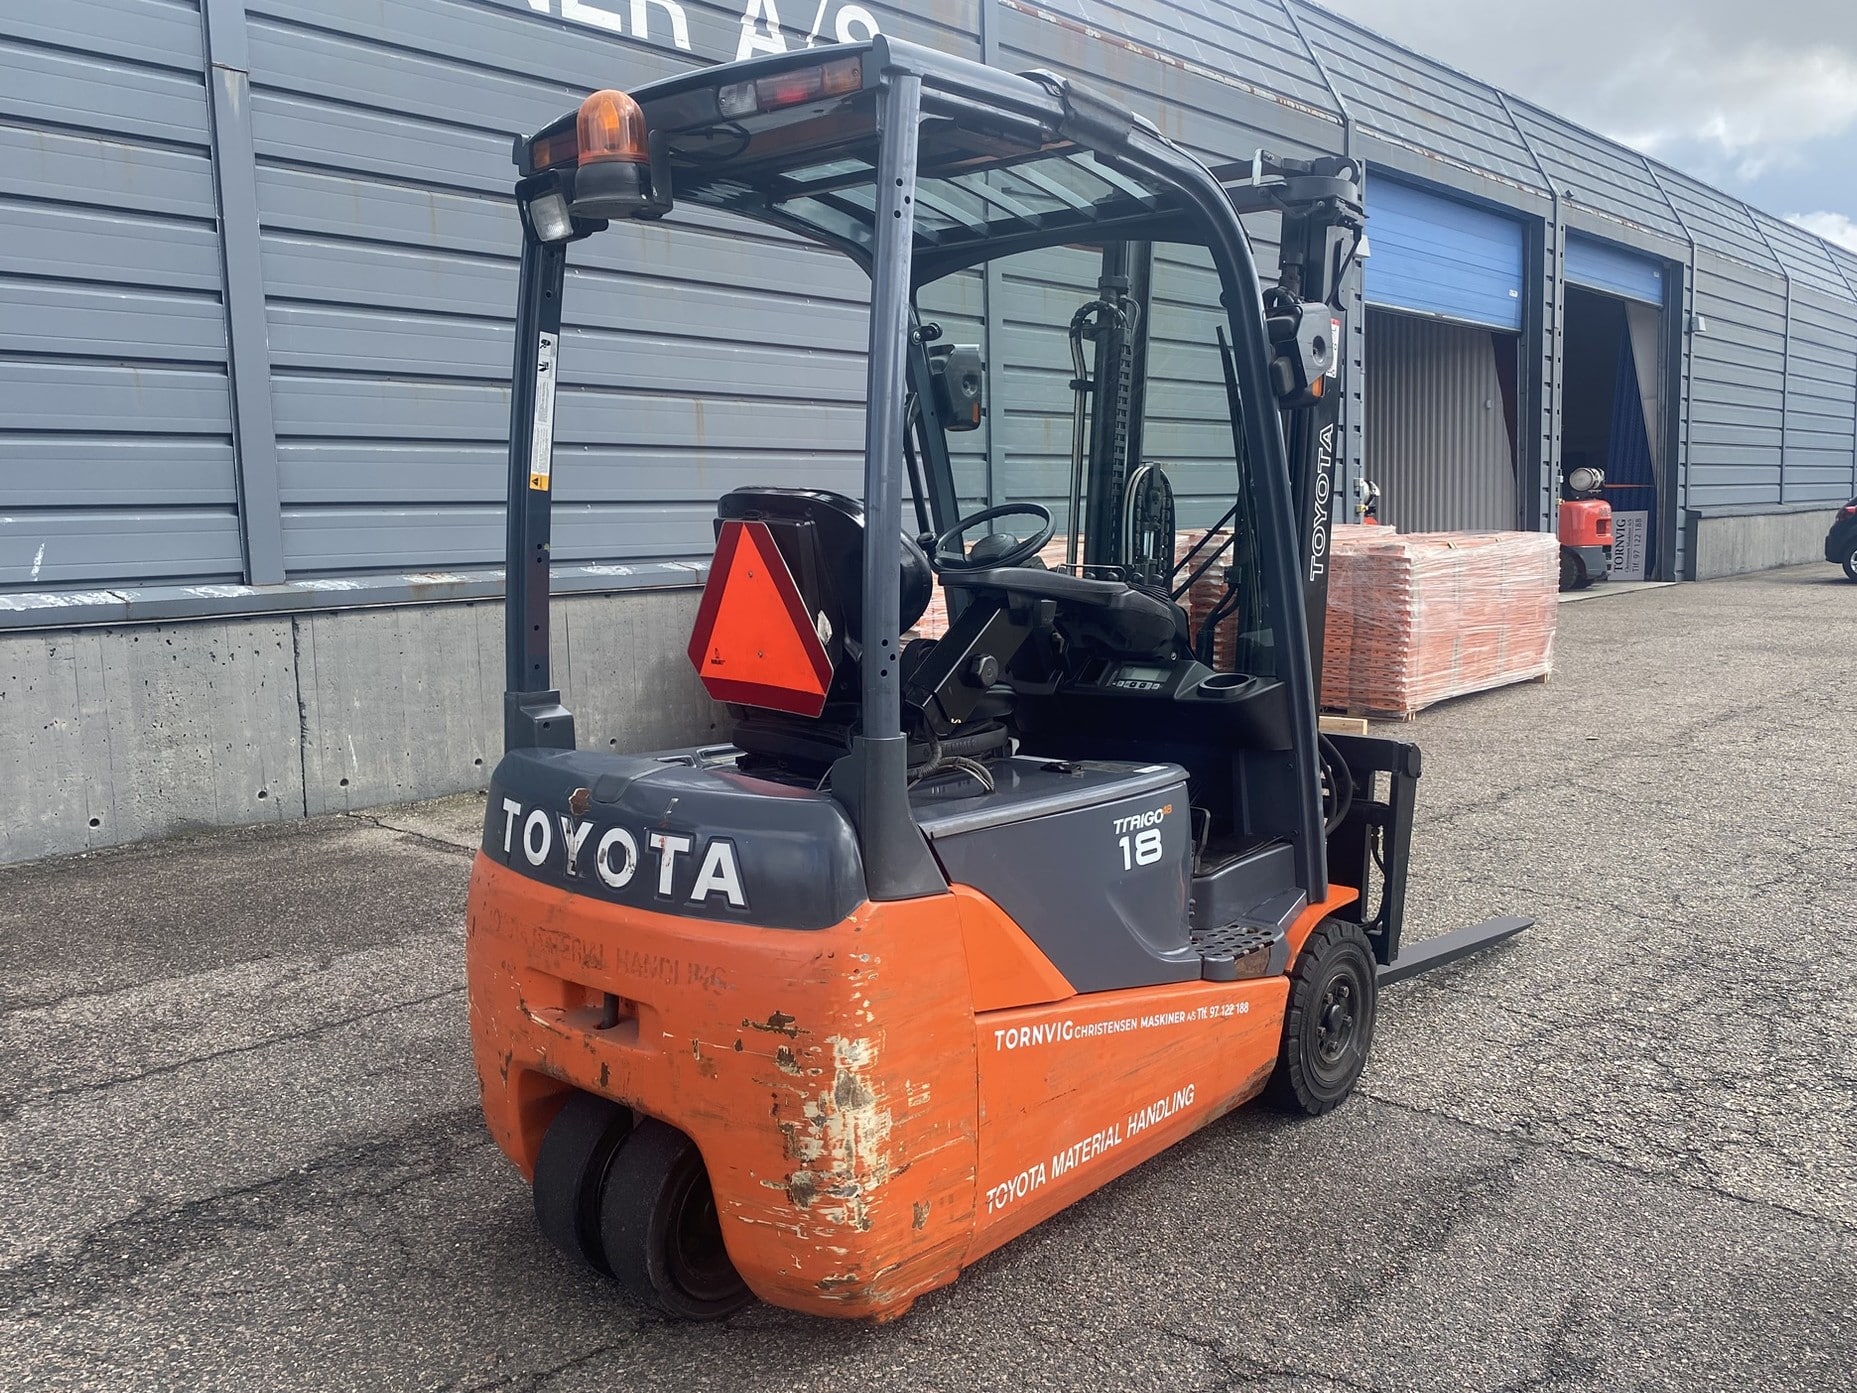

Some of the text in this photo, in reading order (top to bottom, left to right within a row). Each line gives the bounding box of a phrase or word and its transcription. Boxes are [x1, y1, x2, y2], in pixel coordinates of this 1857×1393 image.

[1310, 423, 1334, 582] TOYOTA
[1614, 519, 1626, 573] TORNVIG
[502, 797, 746, 906] TOYOTA
[1119, 828, 1163, 871] 18
[994, 1020, 1074, 1051] TORNVIG
[1074, 1018, 1138, 1039] CHRISTENSEN
[1140, 1011, 1185, 1028] MASKINER
[986, 1084, 1195, 1214] TOYOTA MATERIAL HANDLING
